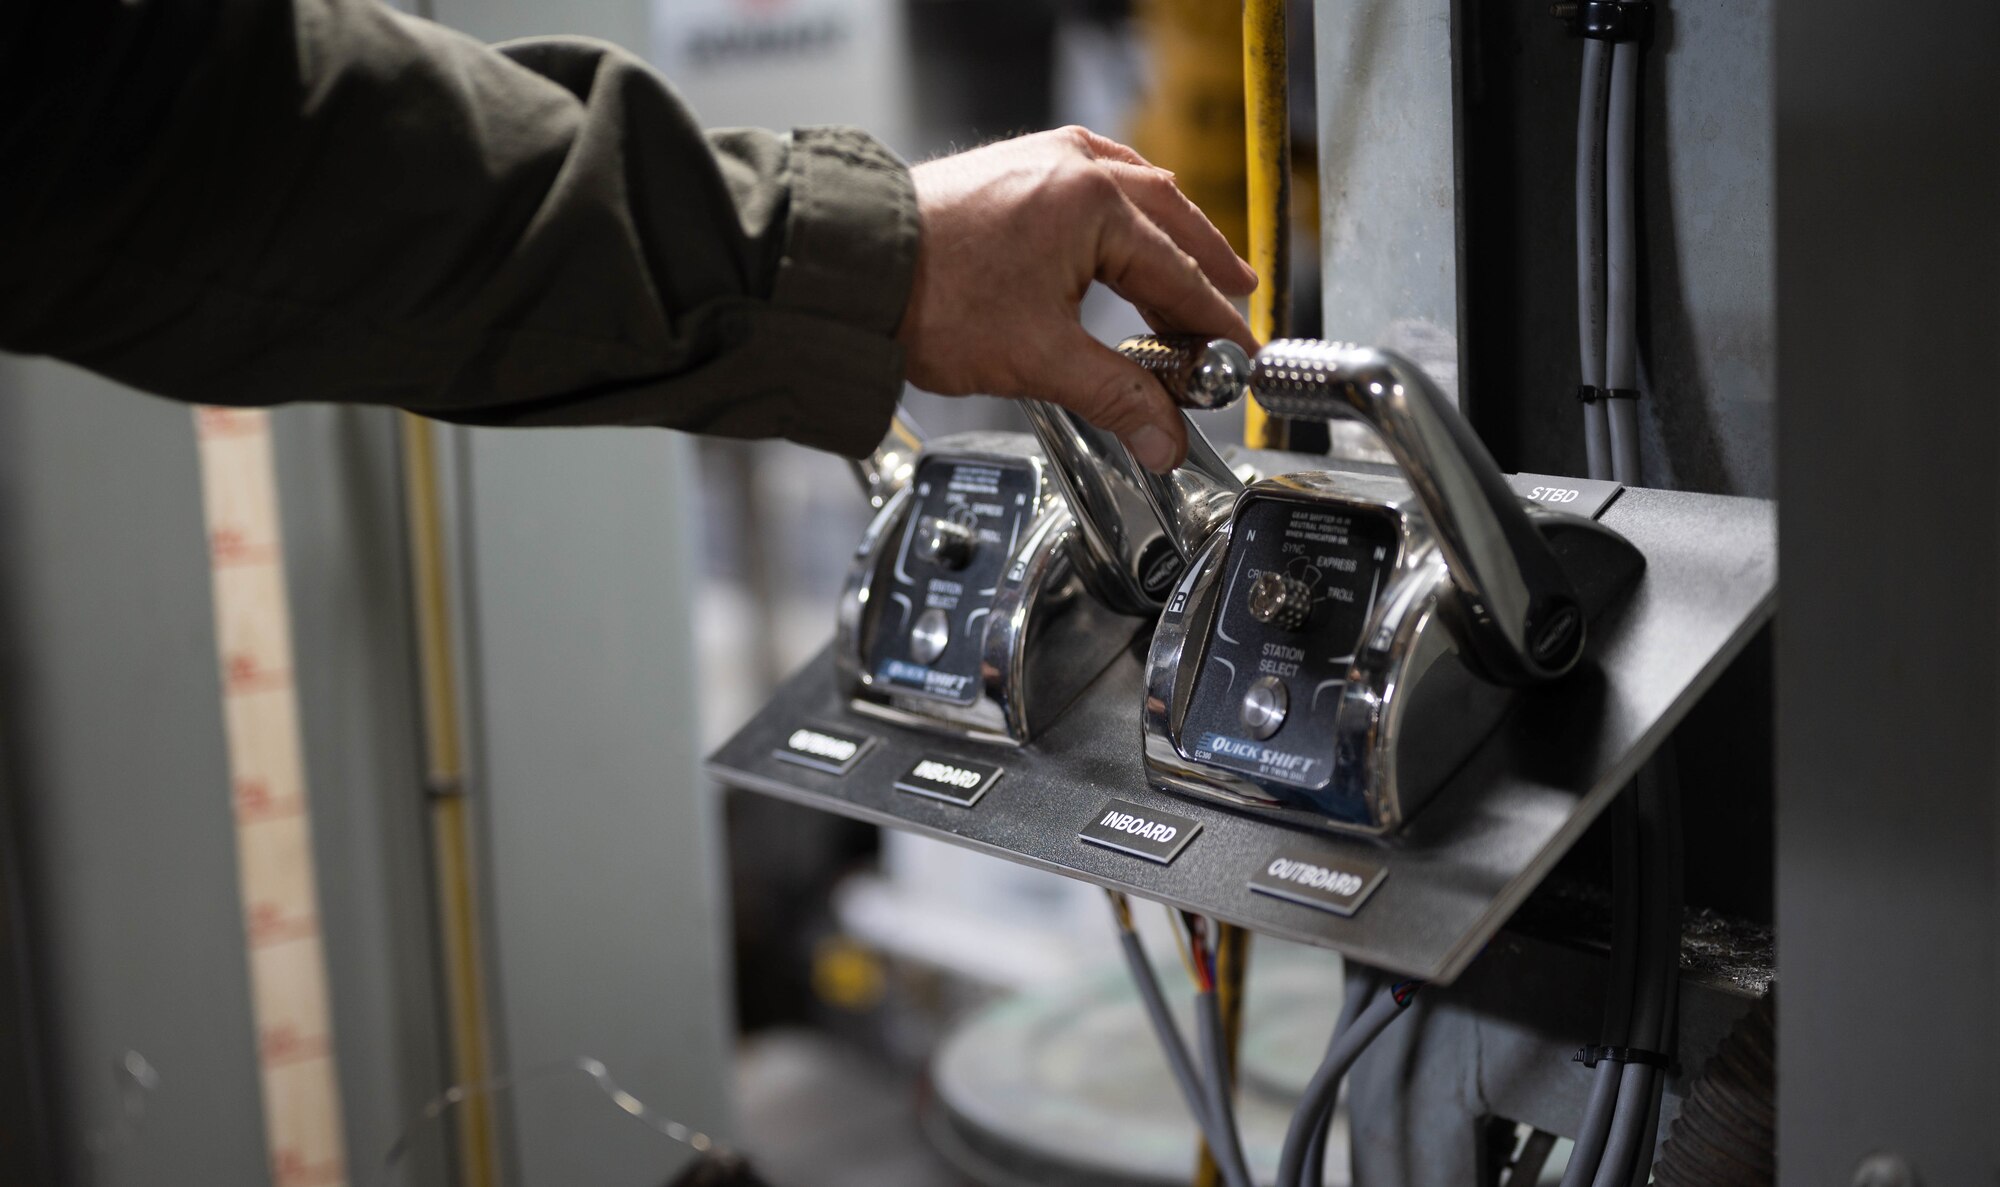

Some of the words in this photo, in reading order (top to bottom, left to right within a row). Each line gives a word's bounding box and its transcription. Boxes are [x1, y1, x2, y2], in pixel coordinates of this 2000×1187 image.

[1526, 486, 1580, 503] STBD
[1289, 520, 1317, 531] NEUTRAL
[1318, 524, 1348, 534] POSITION
[1309, 513, 1335, 524] SHIFTER
[1246, 530, 1256, 542] N
[1285, 529, 1303, 539] WHEN
[1304, 532, 1338, 543] INDICATOR
[1281, 542, 1306, 555] SYNC
[1373, 546, 1386, 561] N
[1316, 555, 1358, 573] EXPRESS
[1170, 591, 1187, 611] R
[1327, 586, 1354, 602] TROLL
[1262, 643, 1305, 661] STATION
[1259, 659, 1299, 677] SELECT
[788, 729, 857, 761] OUTBOARD
[1211, 736, 1261, 759] QUICK
[1260, 749, 1314, 773] SHIFT
[912, 759, 982, 789] INBOARD
[1100, 810, 1177, 843] INBOARD
[1267, 857, 1363, 897] OUTBOARD
